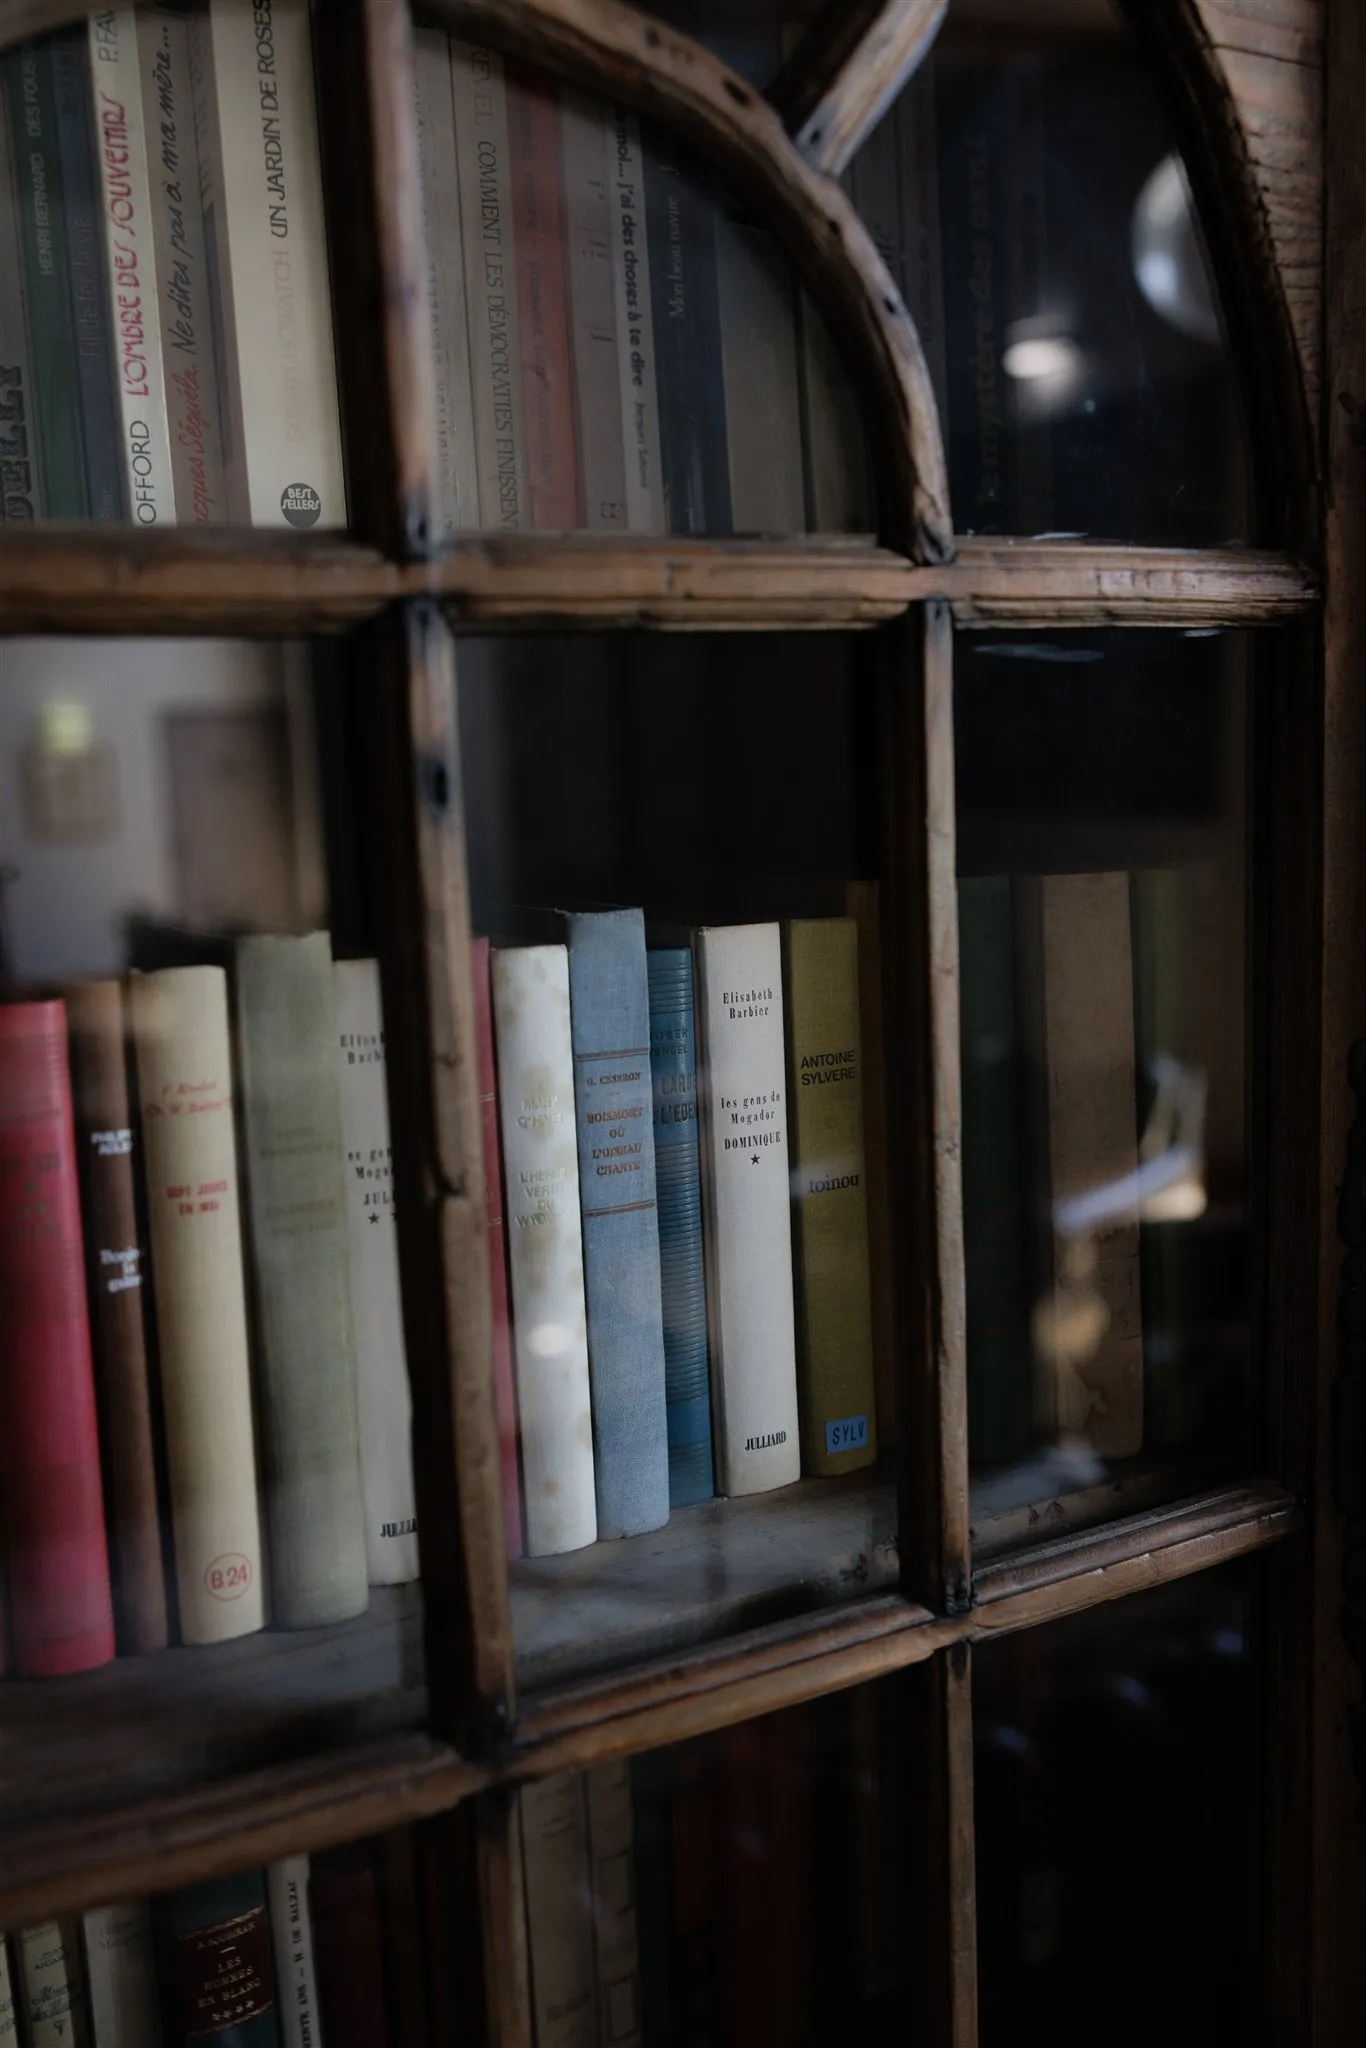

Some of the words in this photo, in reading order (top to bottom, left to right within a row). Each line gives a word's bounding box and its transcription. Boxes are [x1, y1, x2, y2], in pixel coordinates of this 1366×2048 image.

[253, 0, 277, 77] ROSES
[21, 61, 38, 102] FOUS
[471, 45, 494, 125] REVEL
[260, 80, 281, 122] DE
[25, 105, 42, 137] DES
[99, 91, 135, 235] SOUVENIRS
[159, 122, 178, 174] ma
[262, 127, 286, 203] JARDIN
[31, 152, 50, 227] BERNARD
[162, 182, 182, 202] à
[478, 141, 502, 244] COMMENT
[616, 182, 636, 209] j'ai
[72, 216, 92, 244] vie
[167, 208, 193, 260] pas
[266, 205, 289, 240] UN
[621, 214, 638, 245] des
[666, 195, 682, 241] navire
[37, 227, 54, 276] HENRI
[73, 247, 93, 266] la
[113, 240, 139, 289] DES
[667, 243, 684, 280] beau
[485, 252, 503, 287] LES
[624, 250, 642, 307] choses
[968, 238, 992, 302] des
[166, 263, 194, 319] dites
[668, 283, 686, 320] Mon
[627, 311, 643, 322] à
[115, 294, 149, 396] L'OMBRE
[169, 322, 198, 356] Ne
[629, 328, 645, 347] te
[488, 295, 513, 431] DÉMOCRATIES
[631, 351, 647, 387] dire
[971, 312, 1000, 467] mystère
[129, 420, 156, 525] OFFORD
[282, 499, 319, 510] SELLERS
[287, 488, 312, 499] BEST
[722, 987, 773, 1005] Elisabeth
[728, 1006, 769, 1020] Barbier
[800, 1050, 856, 1070] ANTOINE
[800, 1066, 857, 1087] SYLVERE
[599, 1071, 642, 1085] CESBRON
[720, 1096, 738, 1109] les
[742, 1094, 768, 1110] gens
[770, 1090, 781, 1103] de
[730, 1108, 776, 1126] Mogador
[591, 1142, 642, 1160] L'OISEAU
[723, 1131, 782, 1150] DOMINIQUE
[596, 1161, 641, 1177] CHANTE
[807, 1173, 859, 1194] toinou
[744, 1430, 787, 1452] JULLIARD
[832, 1421, 866, 1446] SYLV
[287, 1878, 299, 1923] BALZAC
[203, 1965, 254, 1992] HOMMES
[216, 1956, 242, 1974] LES
[221, 1977, 262, 2003] BLANC
